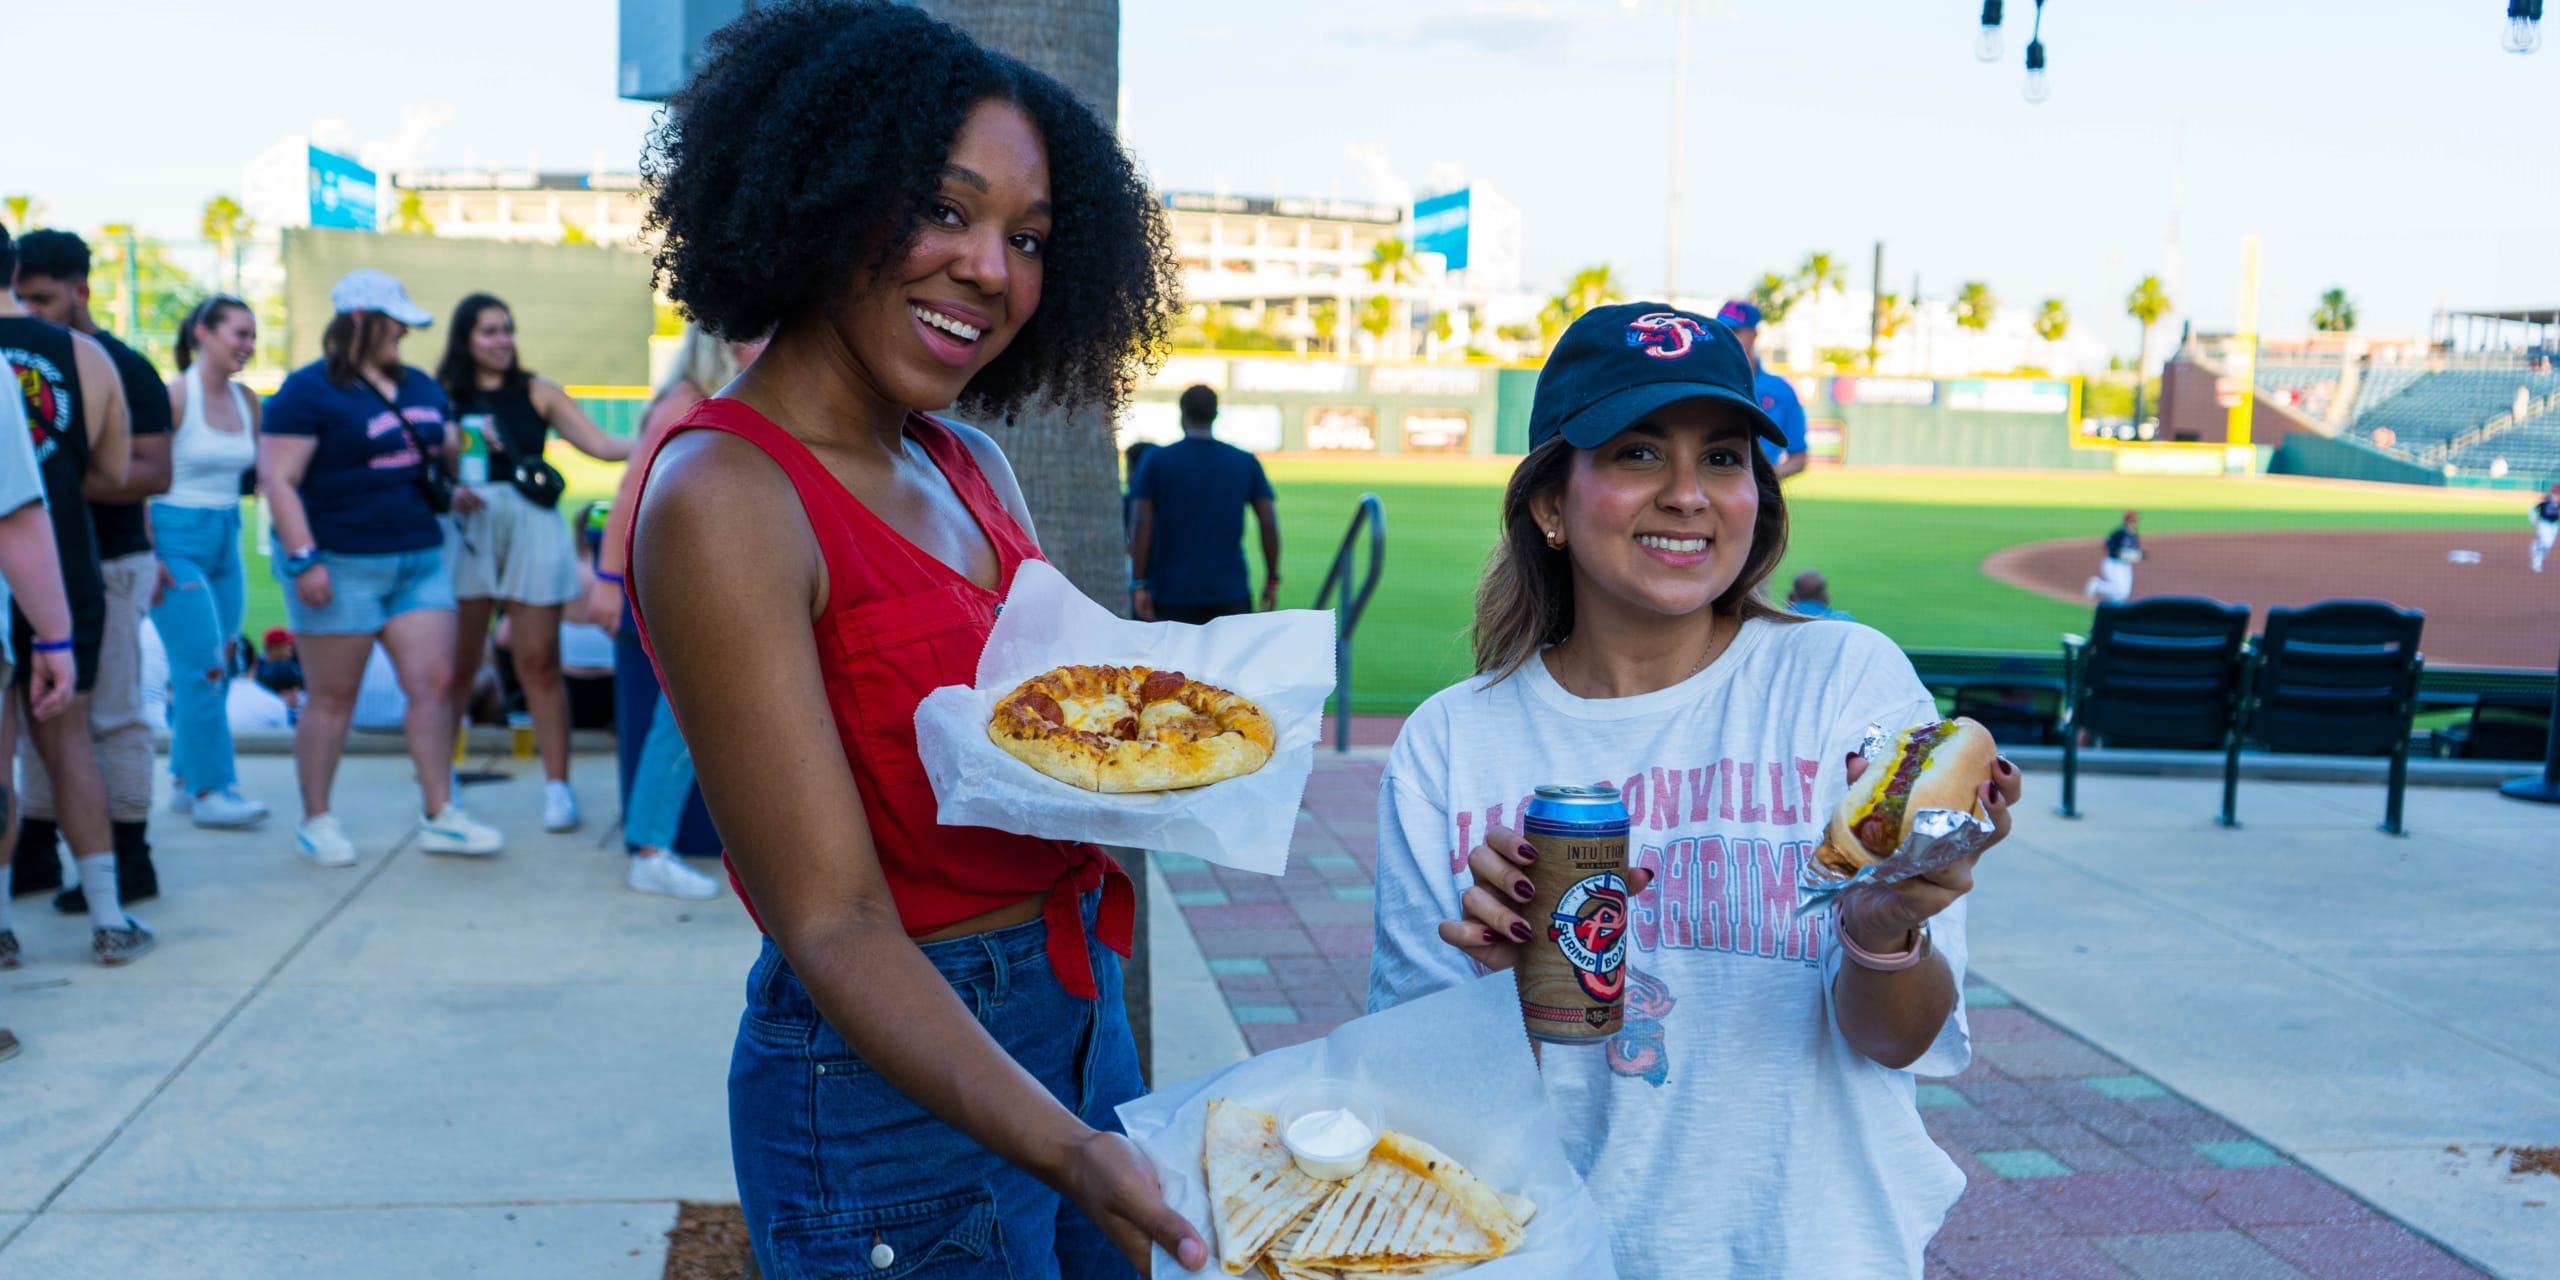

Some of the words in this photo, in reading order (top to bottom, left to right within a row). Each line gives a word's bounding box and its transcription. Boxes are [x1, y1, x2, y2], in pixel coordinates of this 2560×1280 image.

[1450, 758, 1819, 875] JONVILLE
[1567, 844, 1625, 861] INTUITION
[1559, 923, 1595, 967] SHRIMP
[1593, 1010, 1603, 1023] 16
